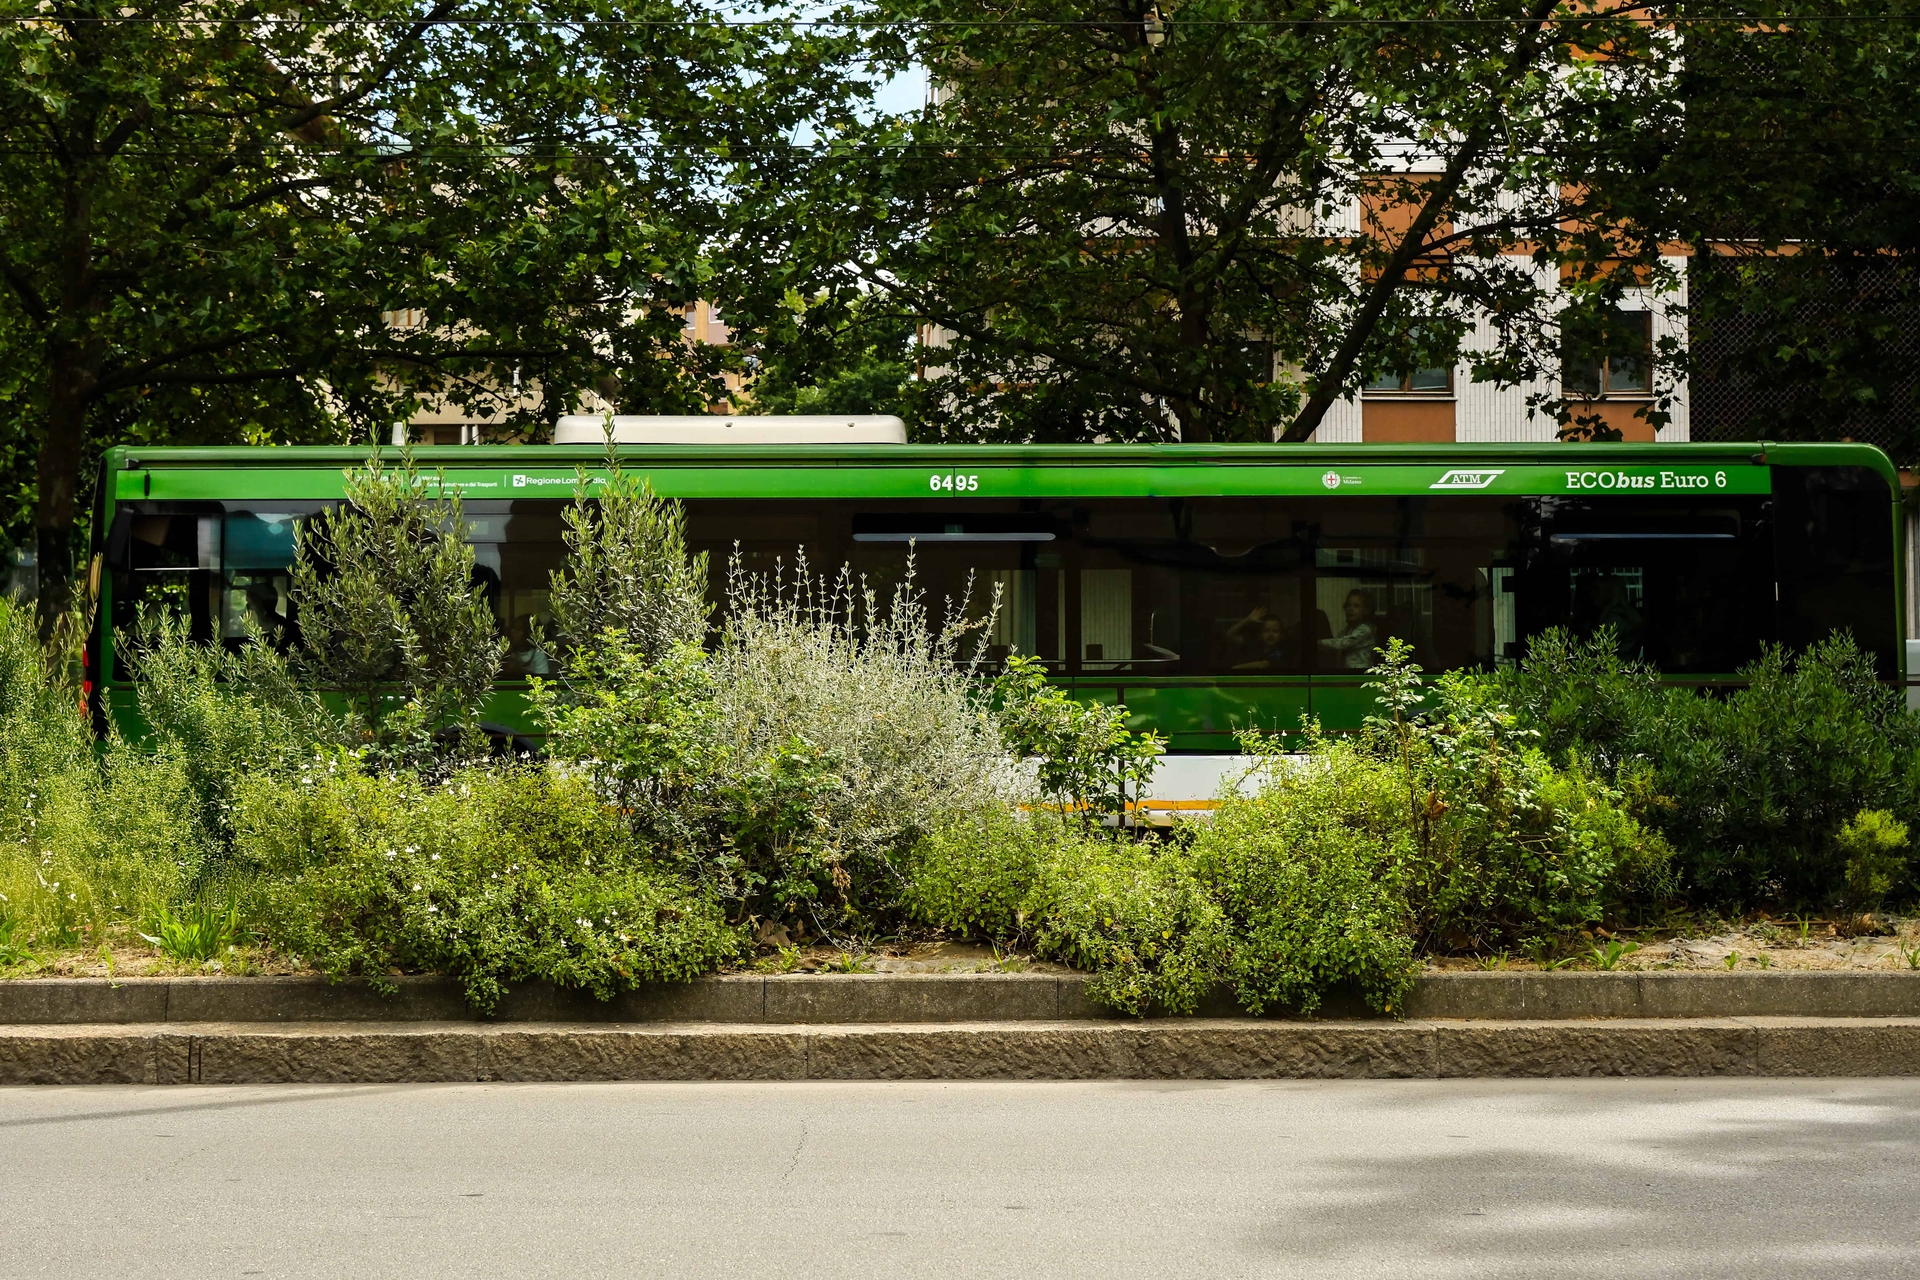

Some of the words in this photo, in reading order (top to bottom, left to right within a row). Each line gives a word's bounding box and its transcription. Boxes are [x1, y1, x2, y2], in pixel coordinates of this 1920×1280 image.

[929, 474, 979, 492] 6495
[1451, 474, 1482, 484] ATM
[1565, 471, 1656, 489] ECObus
[1660, 471, 1709, 489] Euro
[1714, 470, 1727, 488] 6
